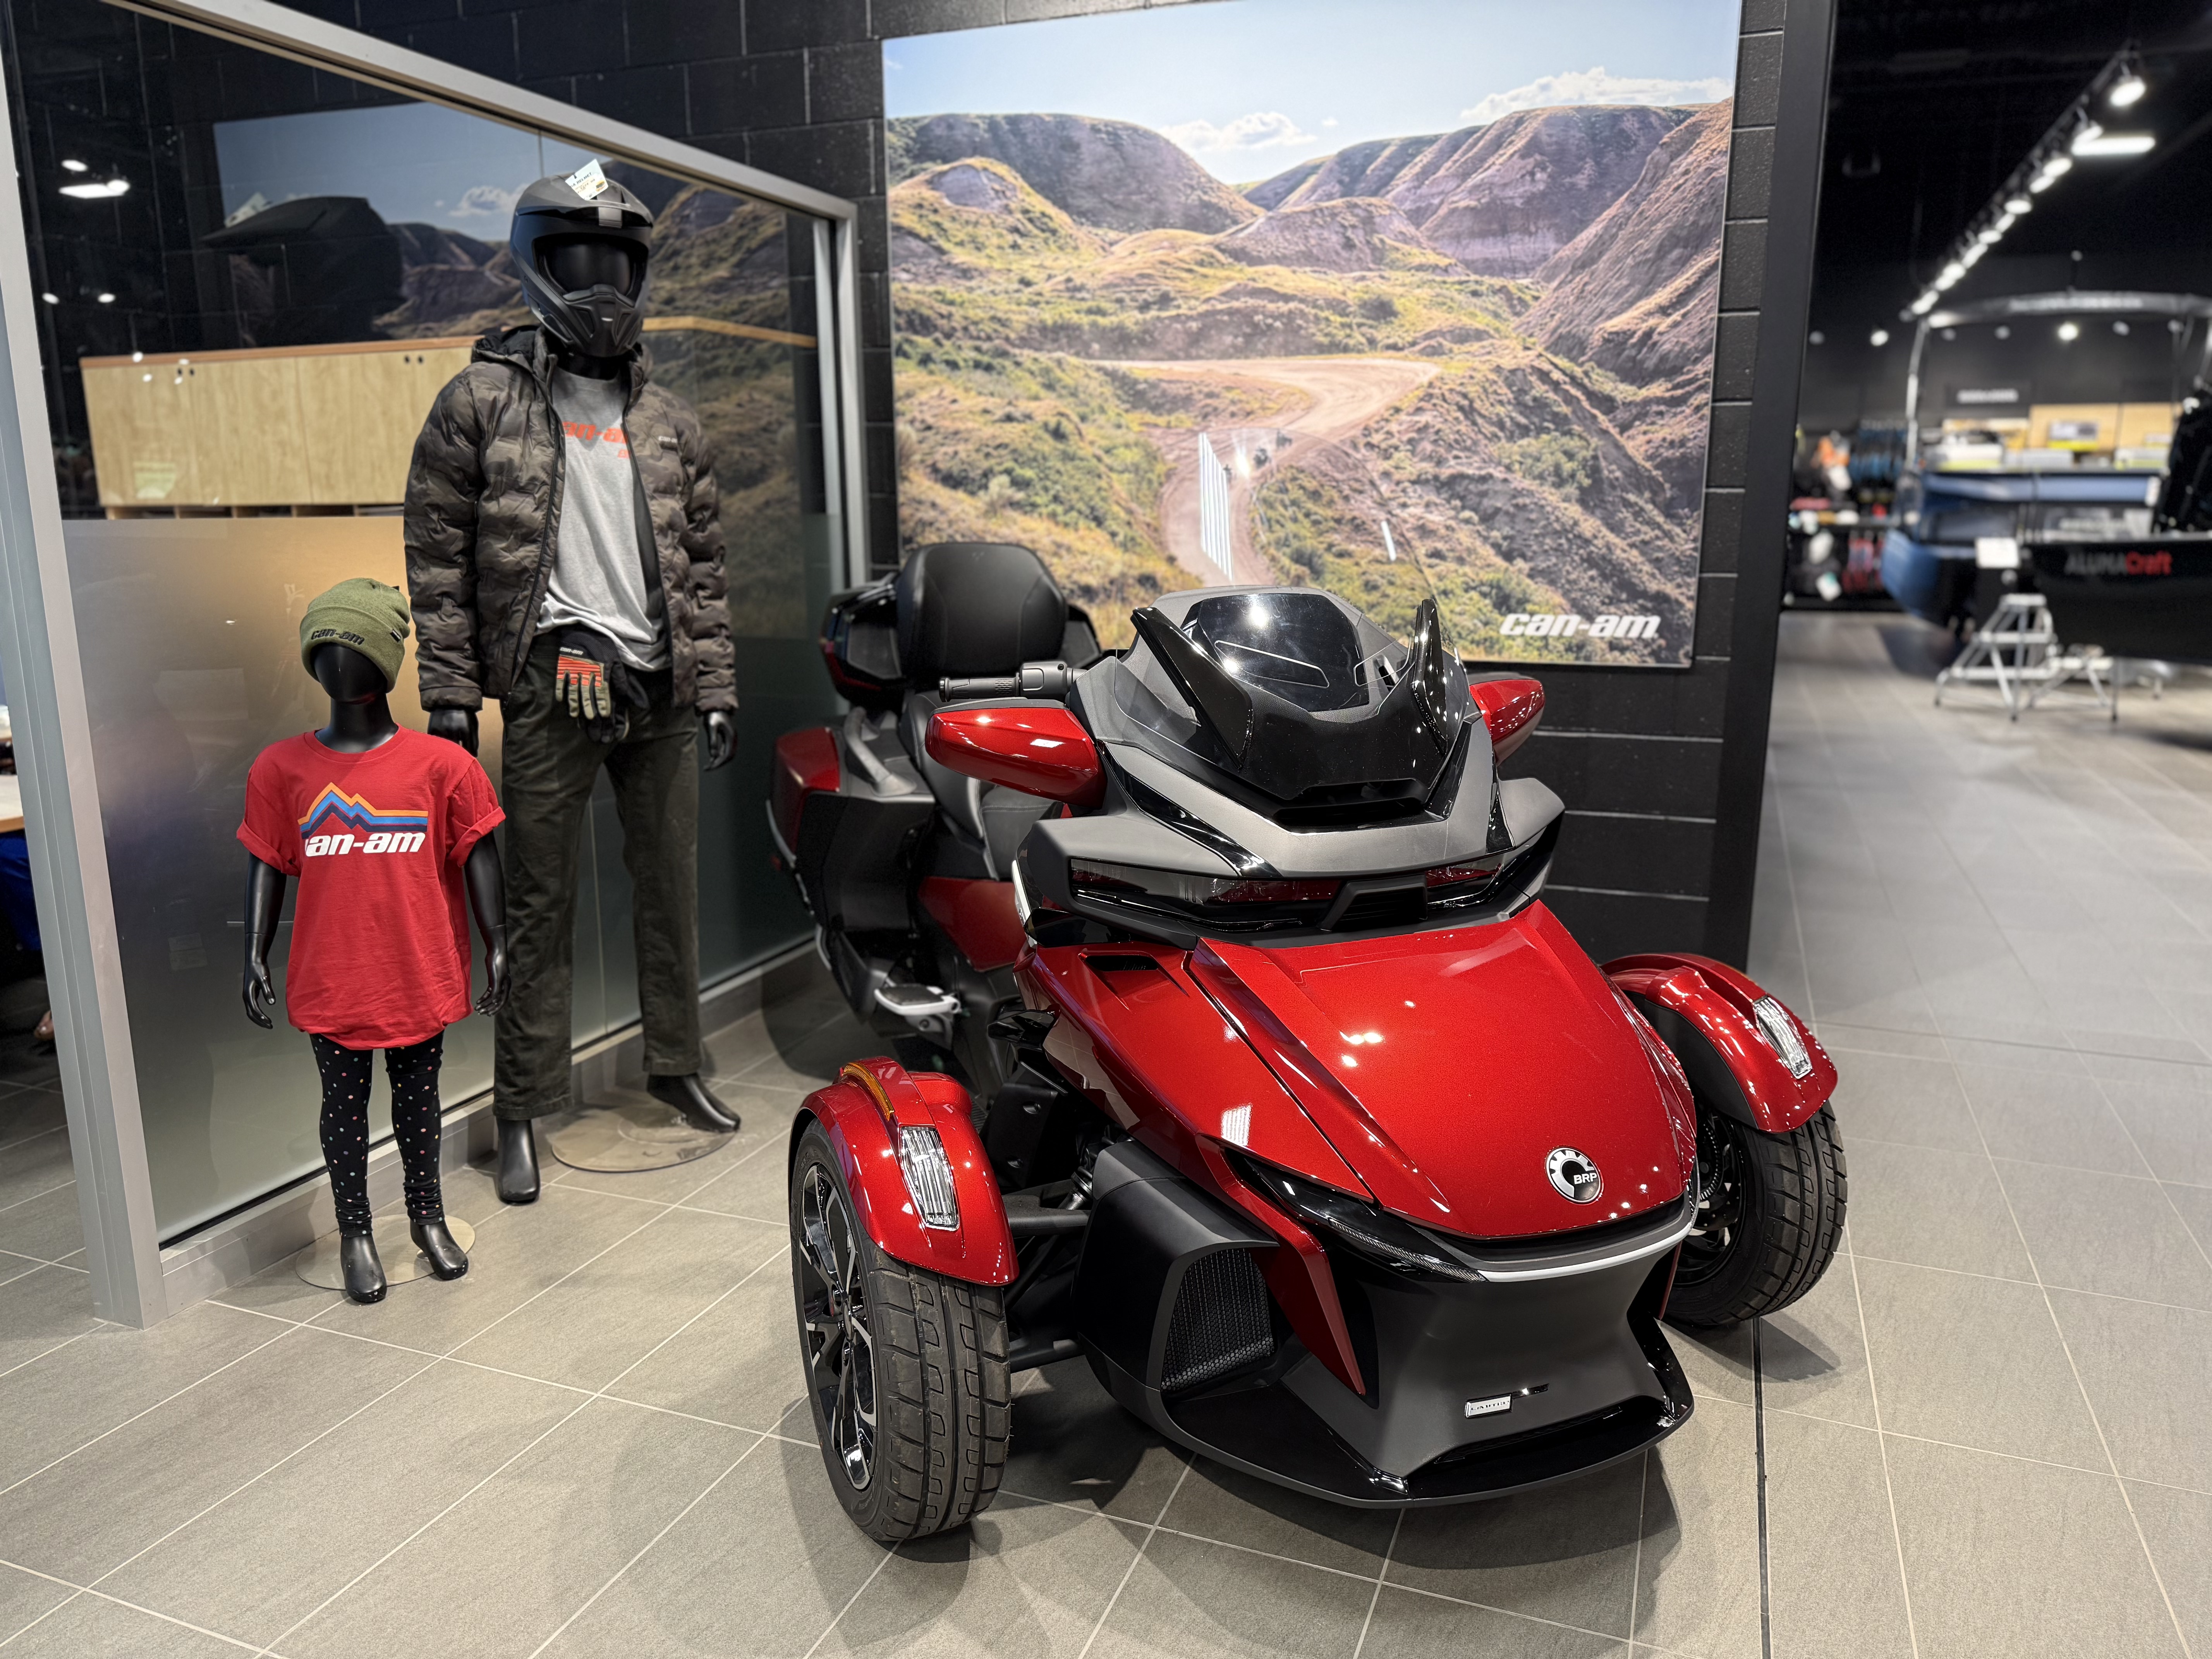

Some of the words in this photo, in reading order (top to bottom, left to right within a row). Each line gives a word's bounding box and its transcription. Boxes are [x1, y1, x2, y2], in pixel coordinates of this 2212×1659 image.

[563, 421, 628, 444] an-a
[311, 628, 365, 645] can-am
[1499, 613, 1661, 639] can-am
[305, 832, 426, 857] an-am
[1573, 1172, 1597, 1185] BRP
